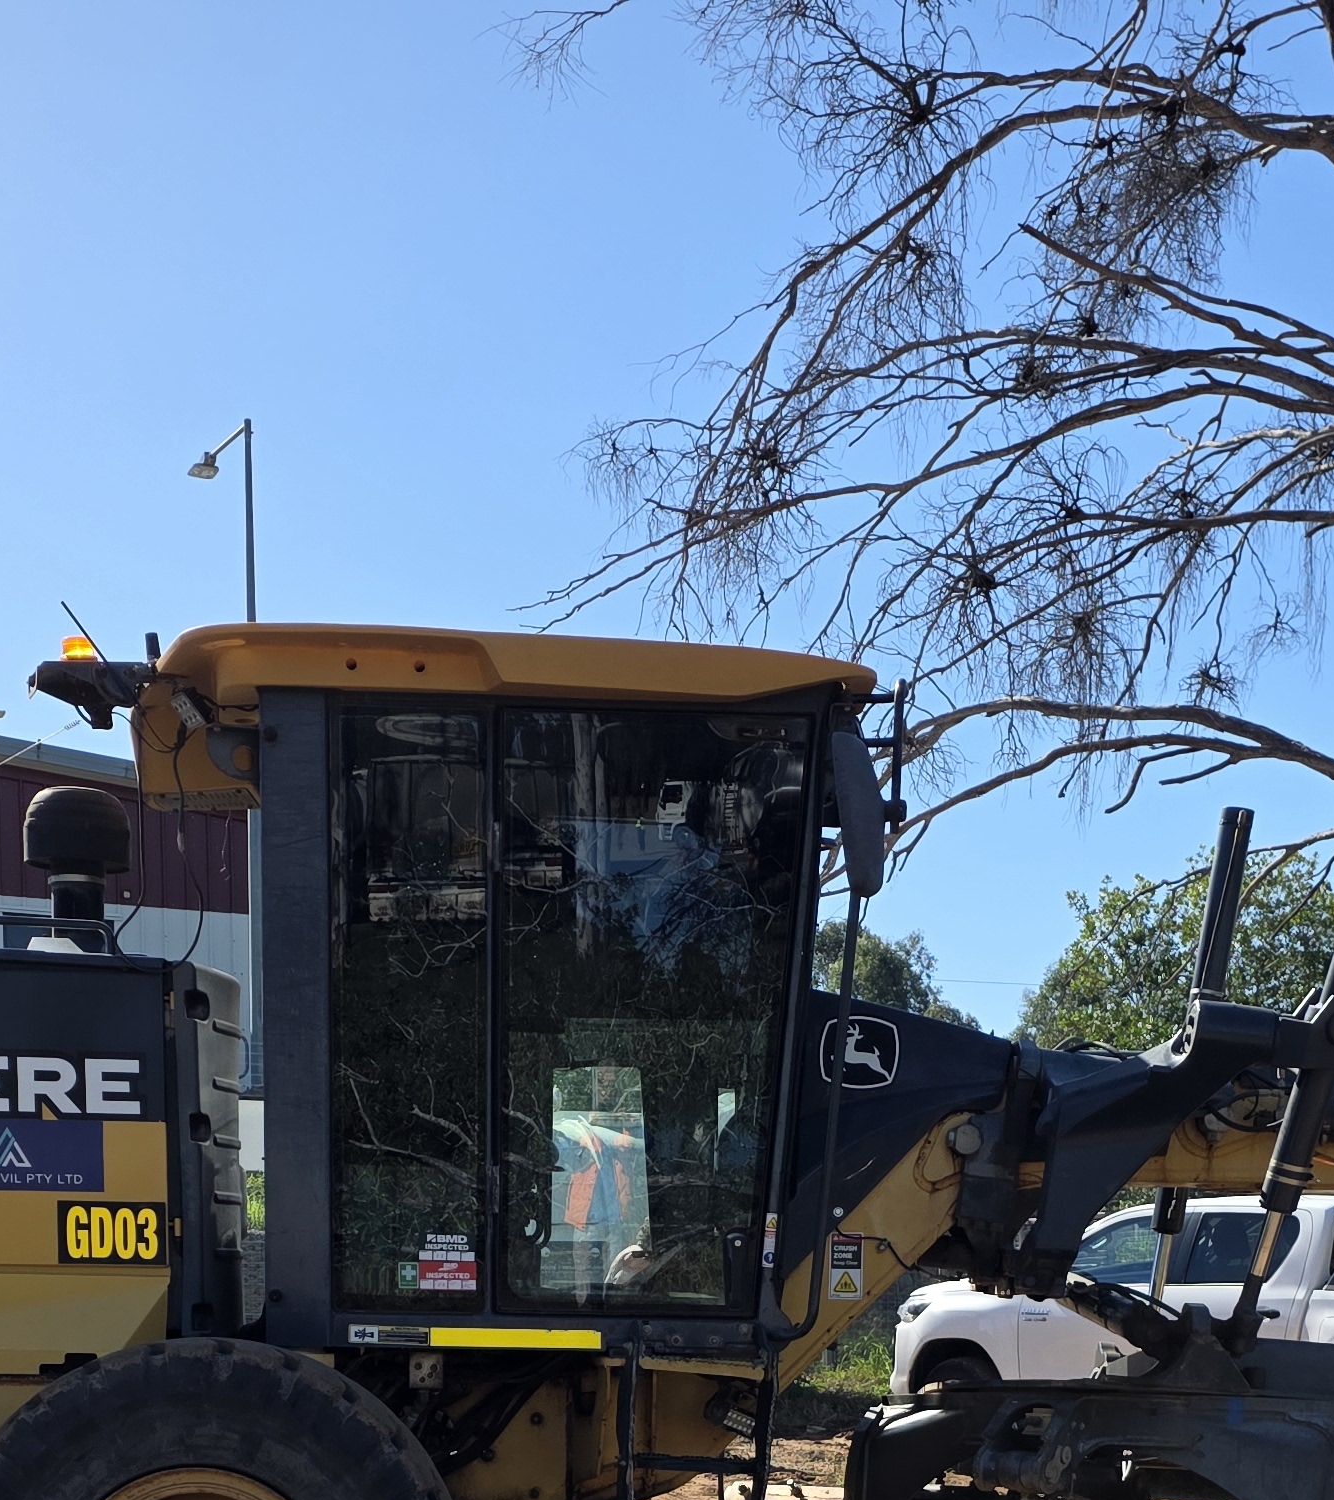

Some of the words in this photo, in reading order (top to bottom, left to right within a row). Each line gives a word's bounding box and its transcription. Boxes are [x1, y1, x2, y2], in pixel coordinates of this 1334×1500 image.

[26, 1173, 53, 1185] PTY
[57, 1173, 83, 1185] LTD
[66, 1205, 159, 1261] GD03
[436, 1234, 468, 1244] BMD
[424, 1243, 470, 1251] INSPECTED
